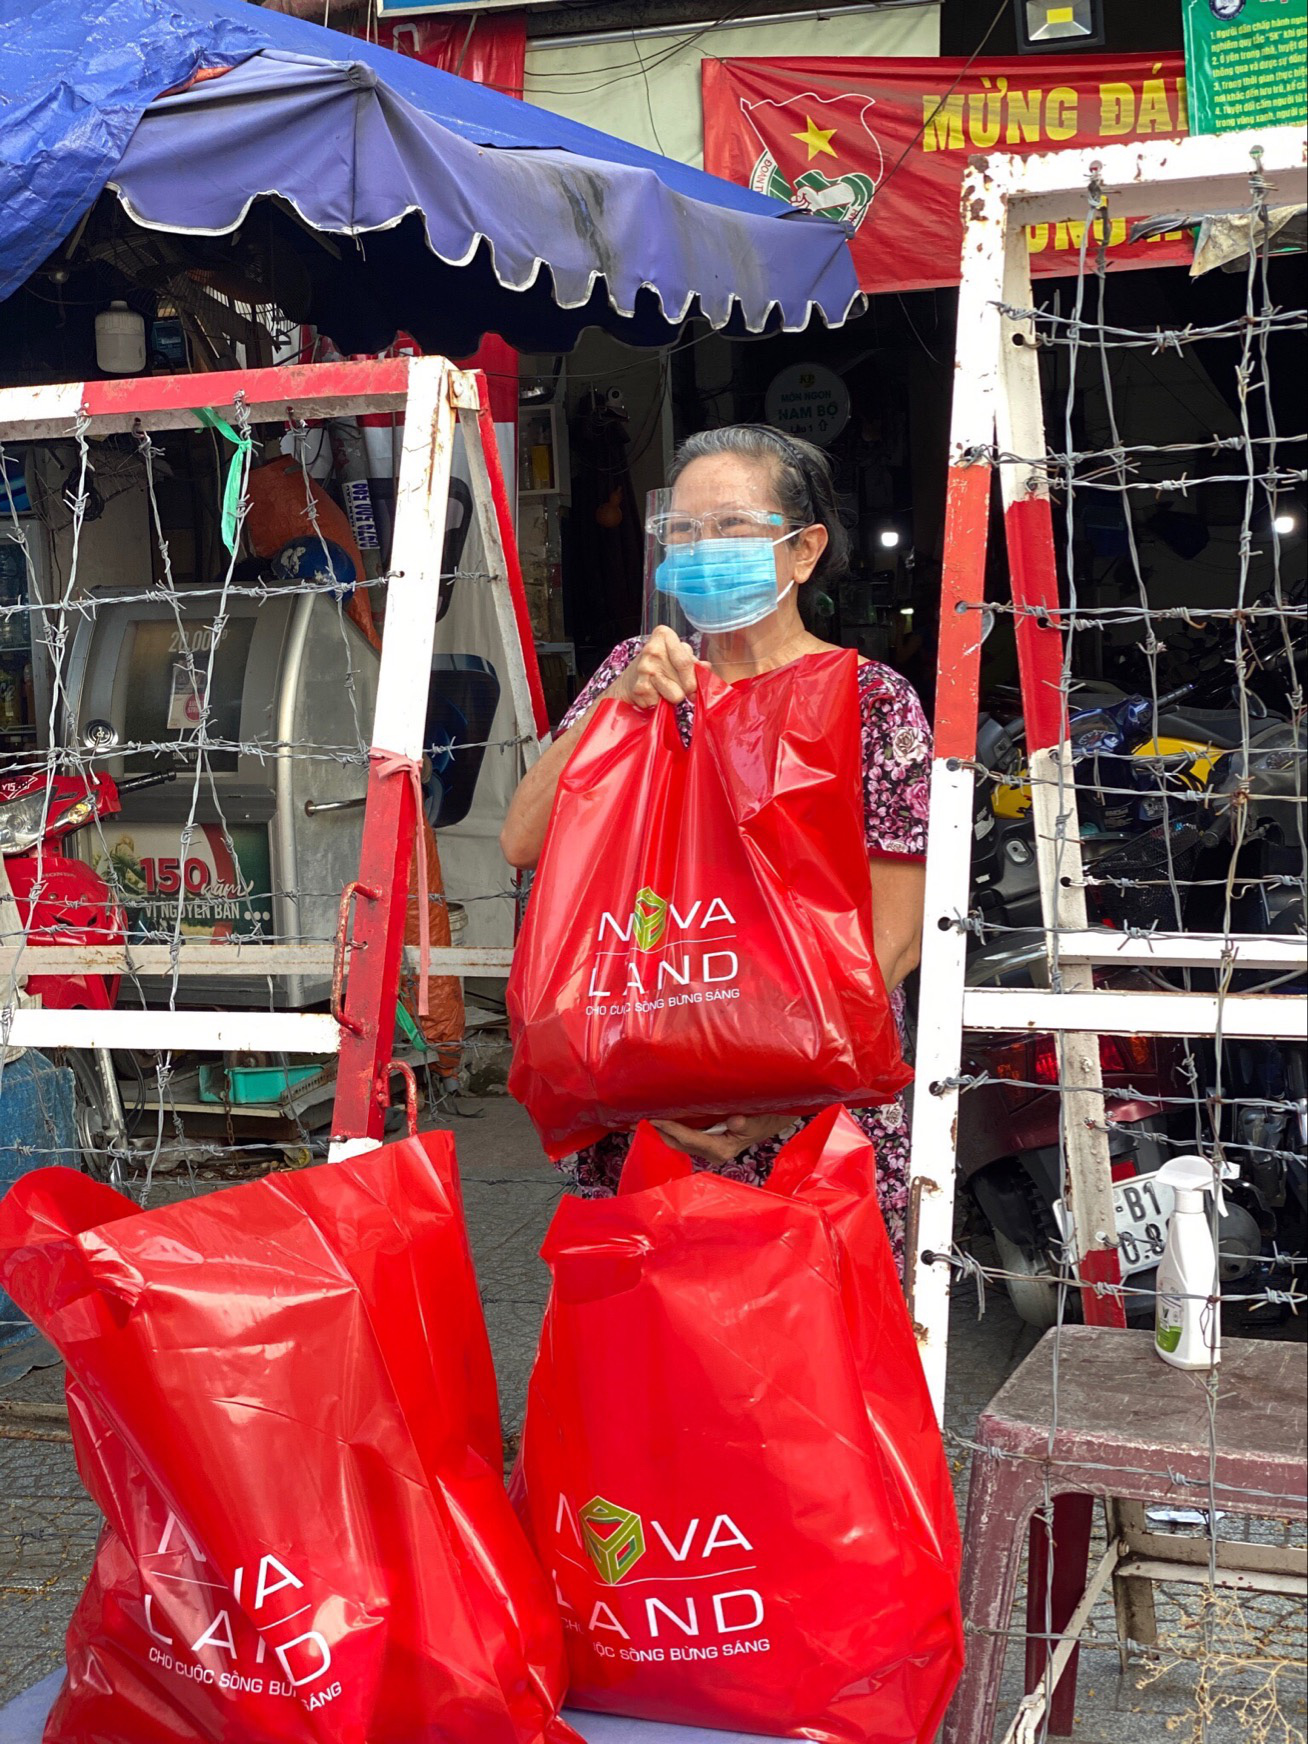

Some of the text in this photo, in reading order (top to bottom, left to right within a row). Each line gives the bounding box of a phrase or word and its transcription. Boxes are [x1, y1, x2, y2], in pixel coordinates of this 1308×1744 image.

[1239, 39, 1251, 47] quy
[1283, 29, 1295, 38] khi
[1226, 52, 1239, 63] yên
[1240, 50, 1260, 59] trong
[1235, 65, 1248, 74] qua
[1222, 80, 1242, 89] Trong
[1258, 74, 1274, 84] gian
[923, 77, 1078, 152] MỪNG
[1216, 118, 1235, 127] trong
[778, 402, 838, 420] NAM BỘ
[140, 857, 211, 894] 150
[588, 951, 738, 997] LAND
[586, 1005, 607, 1015] CHO
[705, 988, 740, 1001] SÁNG
[722, 1638, 770, 1656] SÁNG
[149, 1647, 173, 1670] CHO
[175, 1661, 215, 1684] CUỘC
